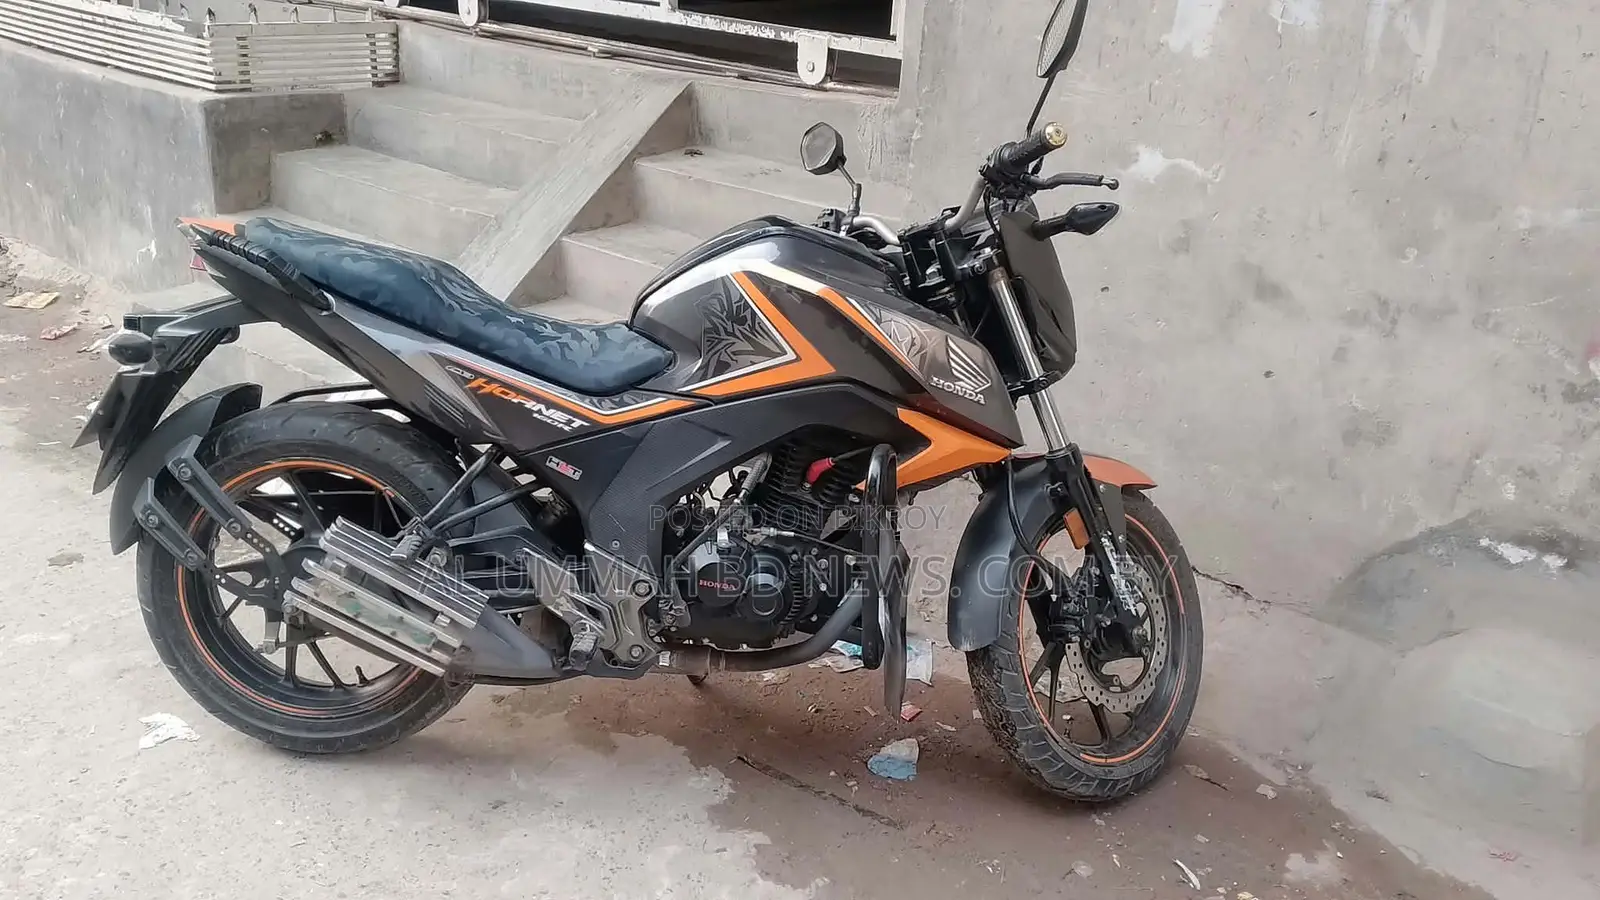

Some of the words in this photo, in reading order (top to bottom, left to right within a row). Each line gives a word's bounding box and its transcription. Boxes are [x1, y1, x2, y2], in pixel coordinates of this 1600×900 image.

[464, 377, 591, 429] HORNET
[930, 376, 986, 405] HONDA
[699, 579, 737, 591] HONDA
